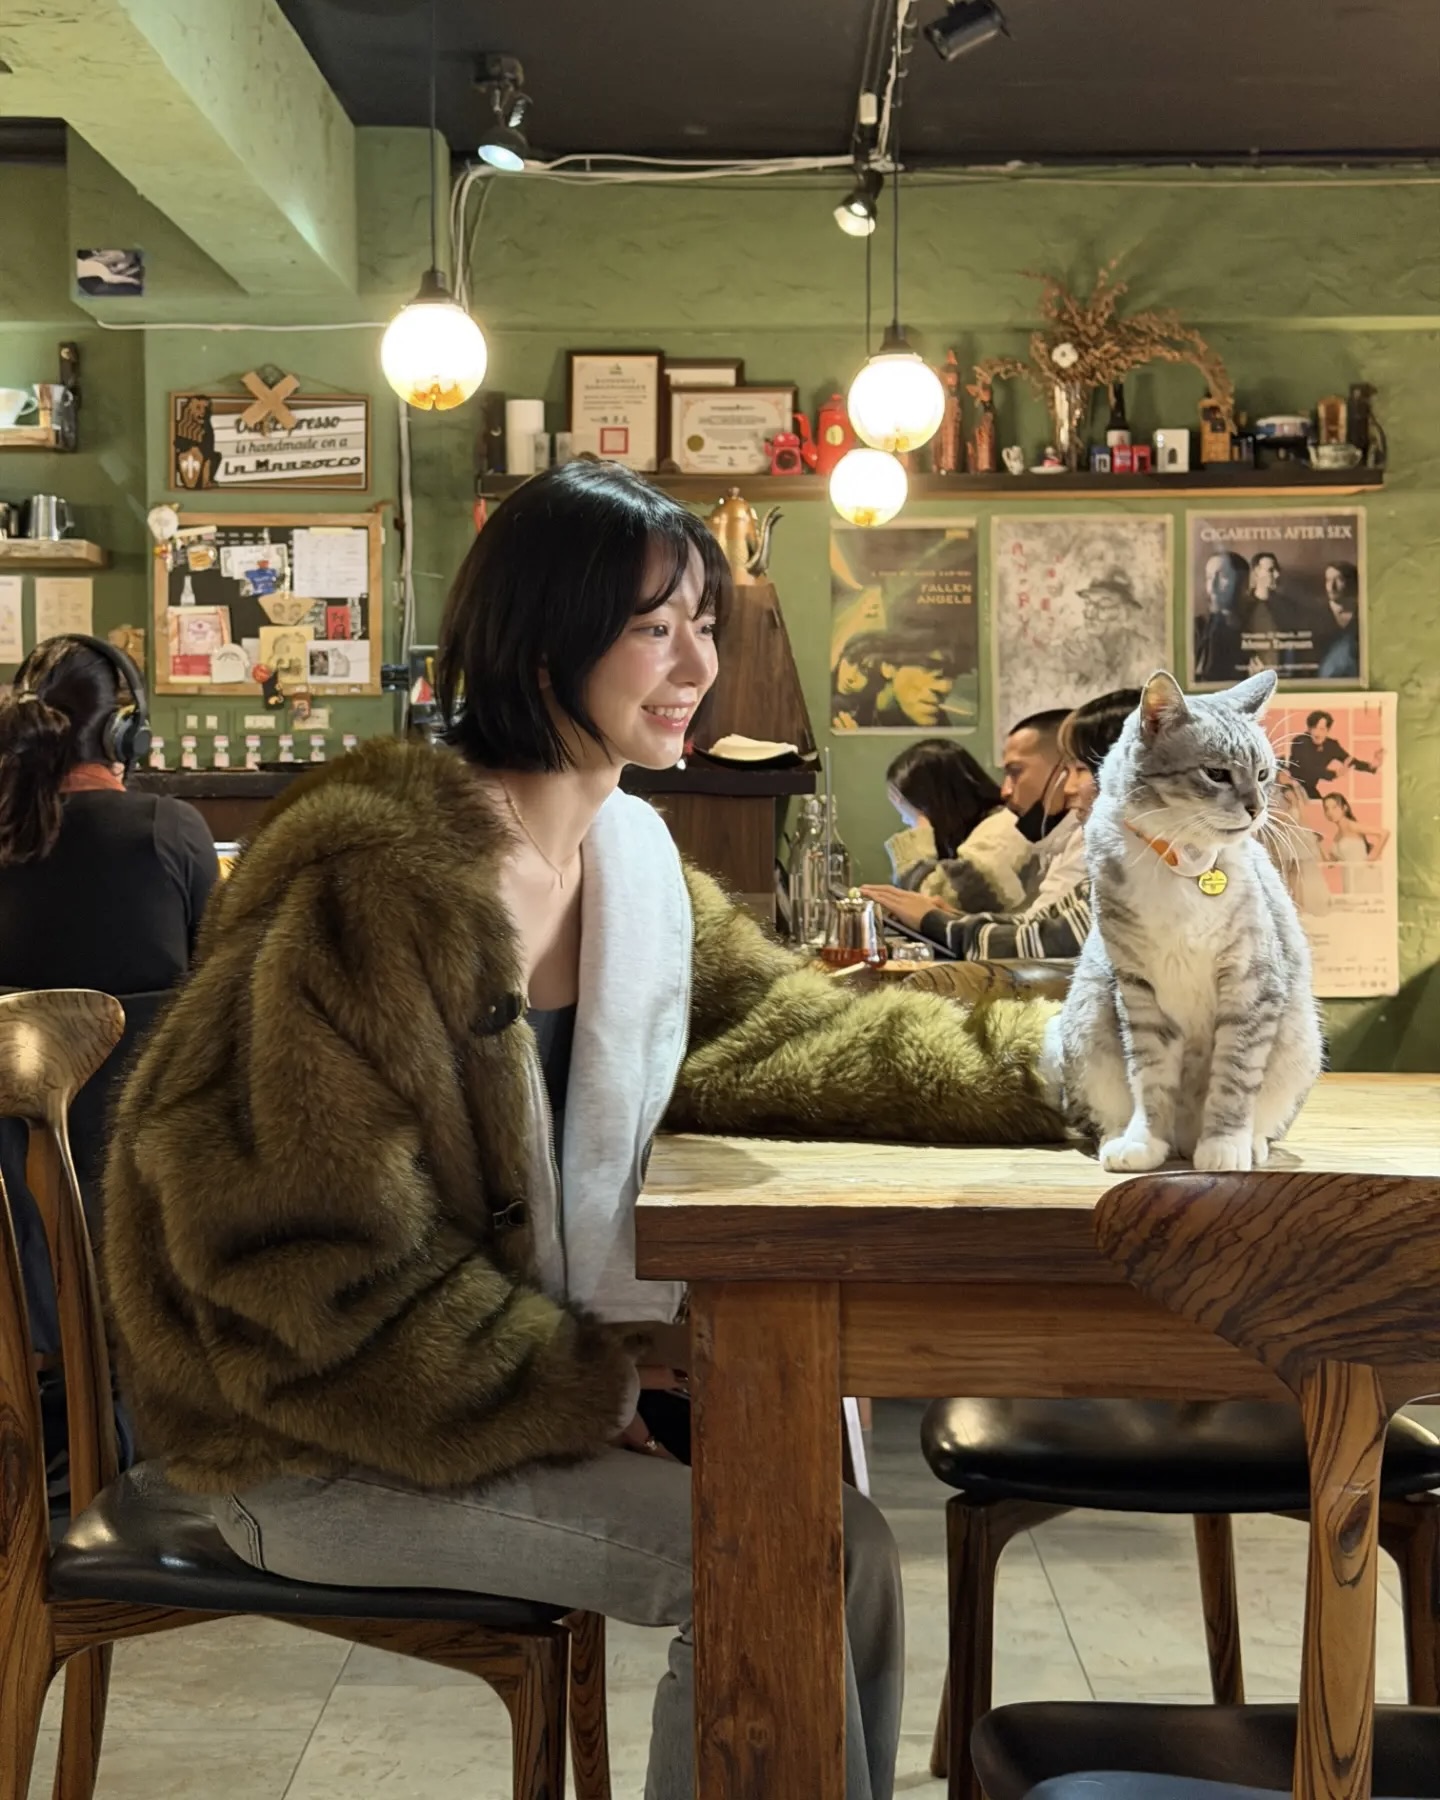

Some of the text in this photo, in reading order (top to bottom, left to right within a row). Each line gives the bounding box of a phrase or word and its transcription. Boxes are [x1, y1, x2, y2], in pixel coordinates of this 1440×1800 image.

[248, 437, 317, 453] handmade
[320, 438, 336, 449] on
[338, 437, 348, 448] a
[1200, 524, 1352, 542] CIGARETTES AFTER SEX
[920, 583, 972, 593] FALLEN
[916, 594, 972, 605] ANGELS
